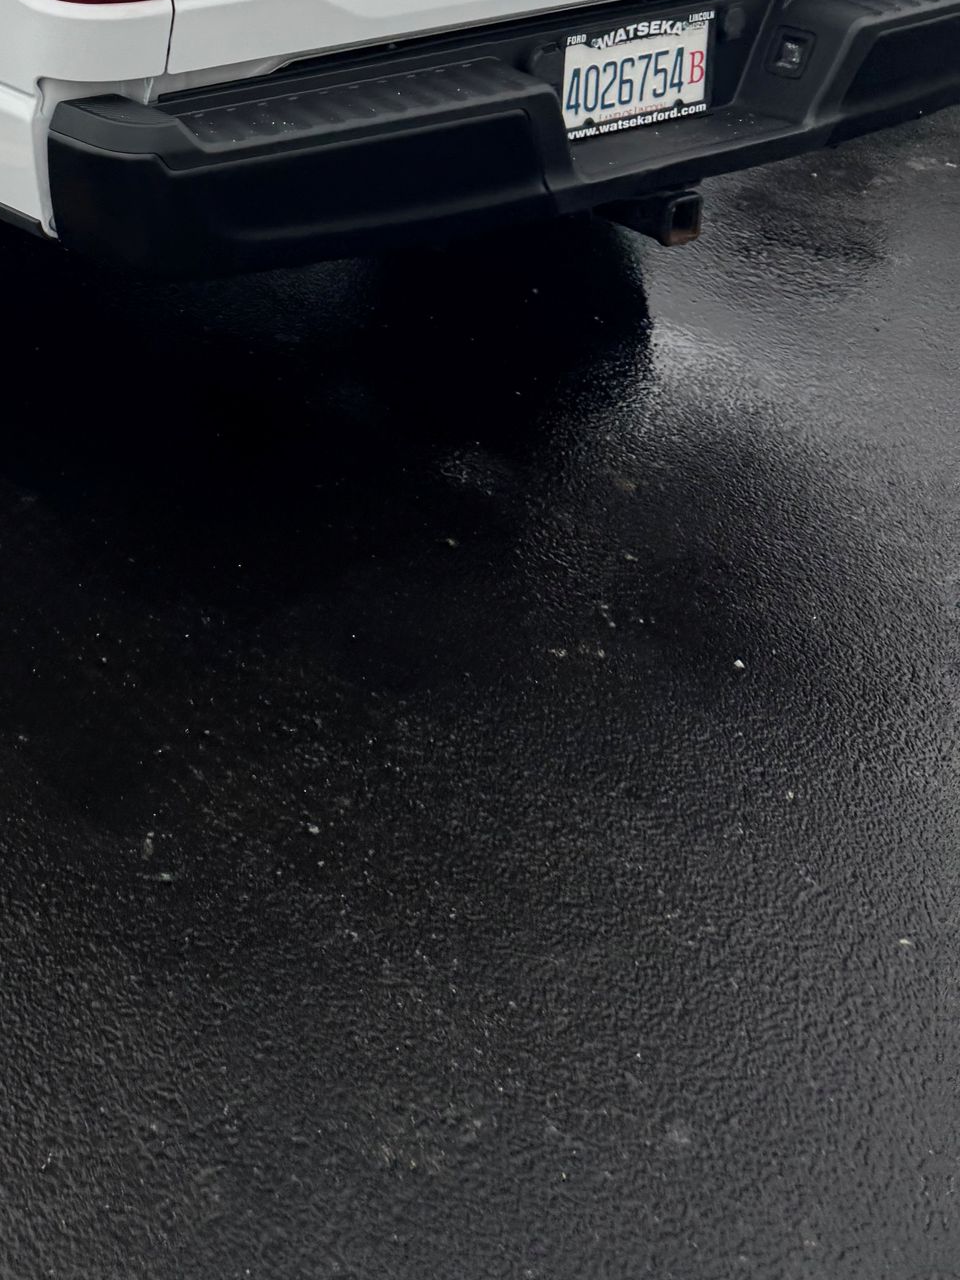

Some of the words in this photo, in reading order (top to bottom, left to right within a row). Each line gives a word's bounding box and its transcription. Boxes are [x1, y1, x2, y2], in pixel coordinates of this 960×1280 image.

[566, 33, 587, 46] FORD
[596, 19, 684, 49] WATSEKA
[688, 10, 715, 23] LINCOLN
[565, 46, 685, 116] 4026754
[567, 102, 707, 141] www.watsekaford.com
